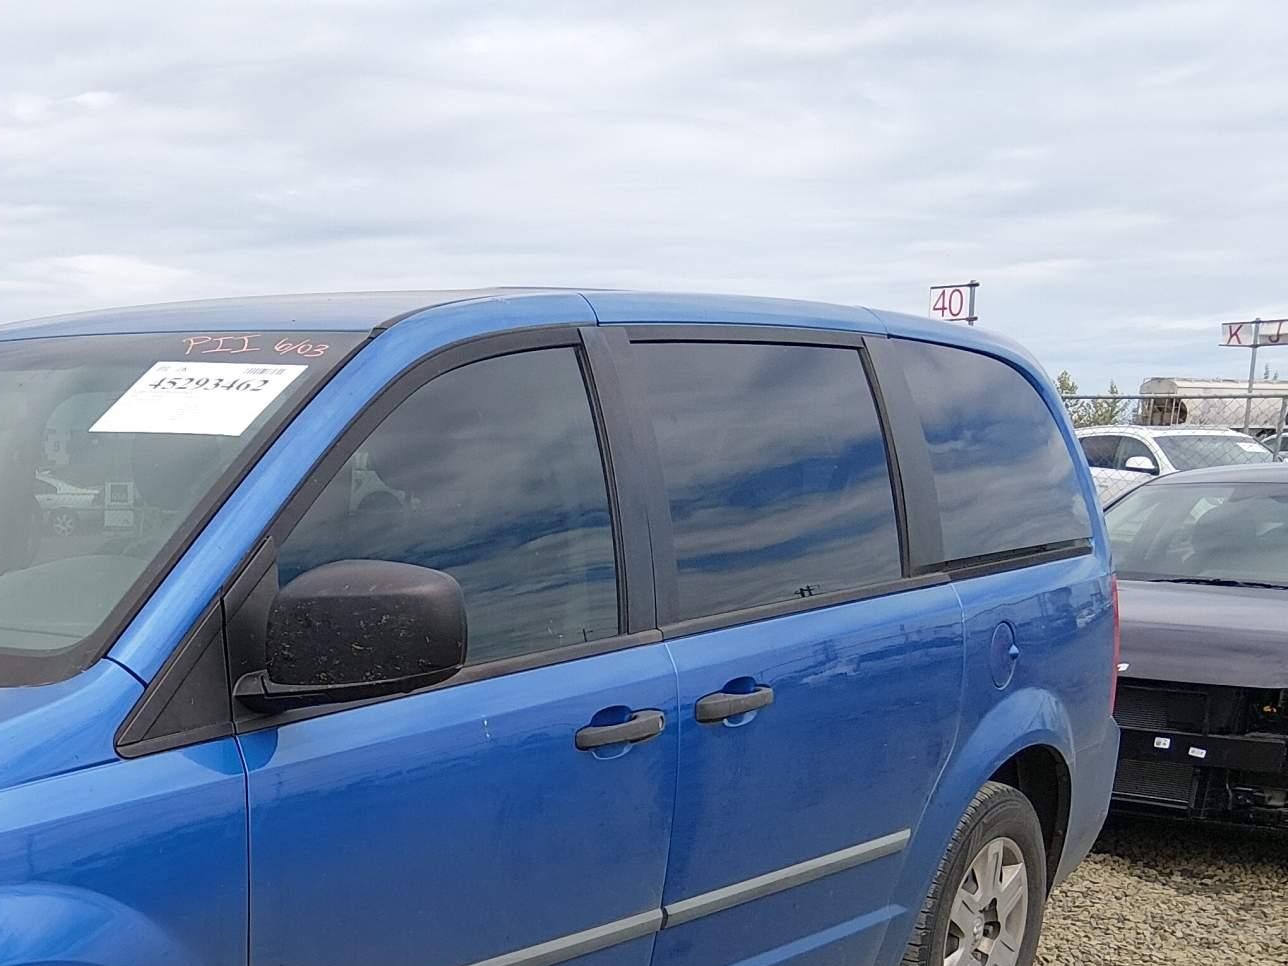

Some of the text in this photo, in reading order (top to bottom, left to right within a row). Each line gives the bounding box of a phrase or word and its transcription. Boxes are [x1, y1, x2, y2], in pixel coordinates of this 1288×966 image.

[932, 289, 964, 317] 40
[1226, 324, 1243, 345] K
[1268, 320, 1282, 343] J
[182, 335, 329, 357] PII 6/03
[149, 376, 269, 392] 45293462
